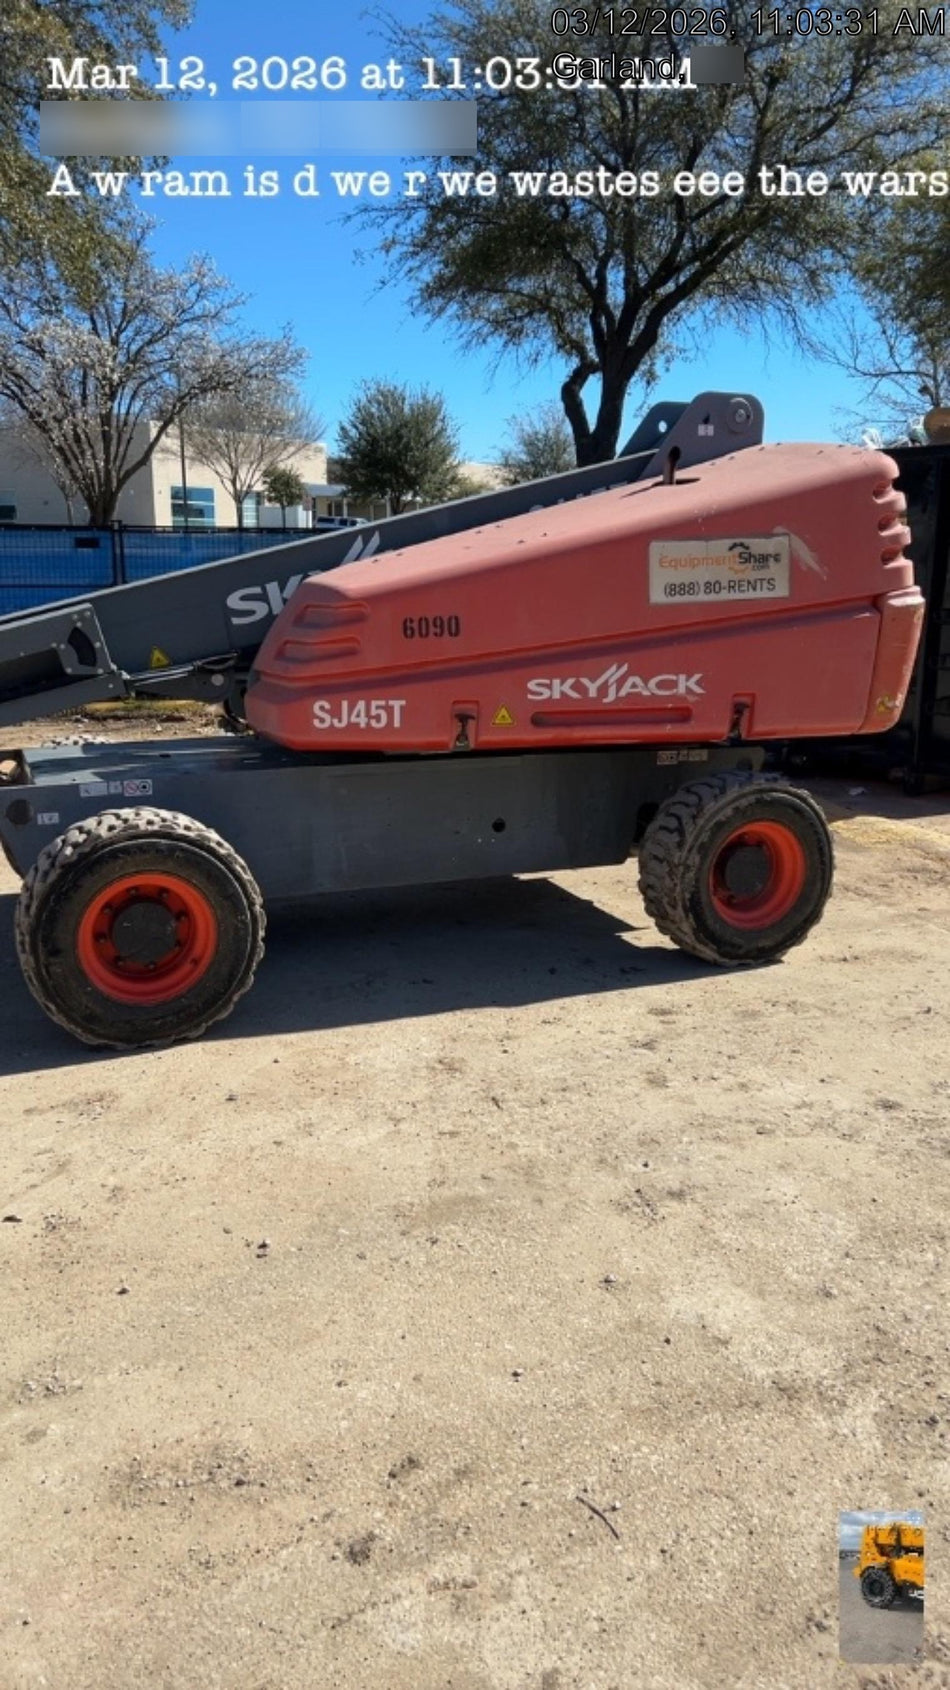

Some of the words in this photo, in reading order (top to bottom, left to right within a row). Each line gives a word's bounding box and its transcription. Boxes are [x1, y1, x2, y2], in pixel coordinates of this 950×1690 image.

[659, 552, 781, 569] EquipmentShare
[664, 581, 700, 597] (888)
[703, 578, 776, 595] 80-RENTS
[403, 615, 461, 639] 6090
[527, 663, 705, 703] SKYJACK
[312, 700, 406, 728] SJ45T
